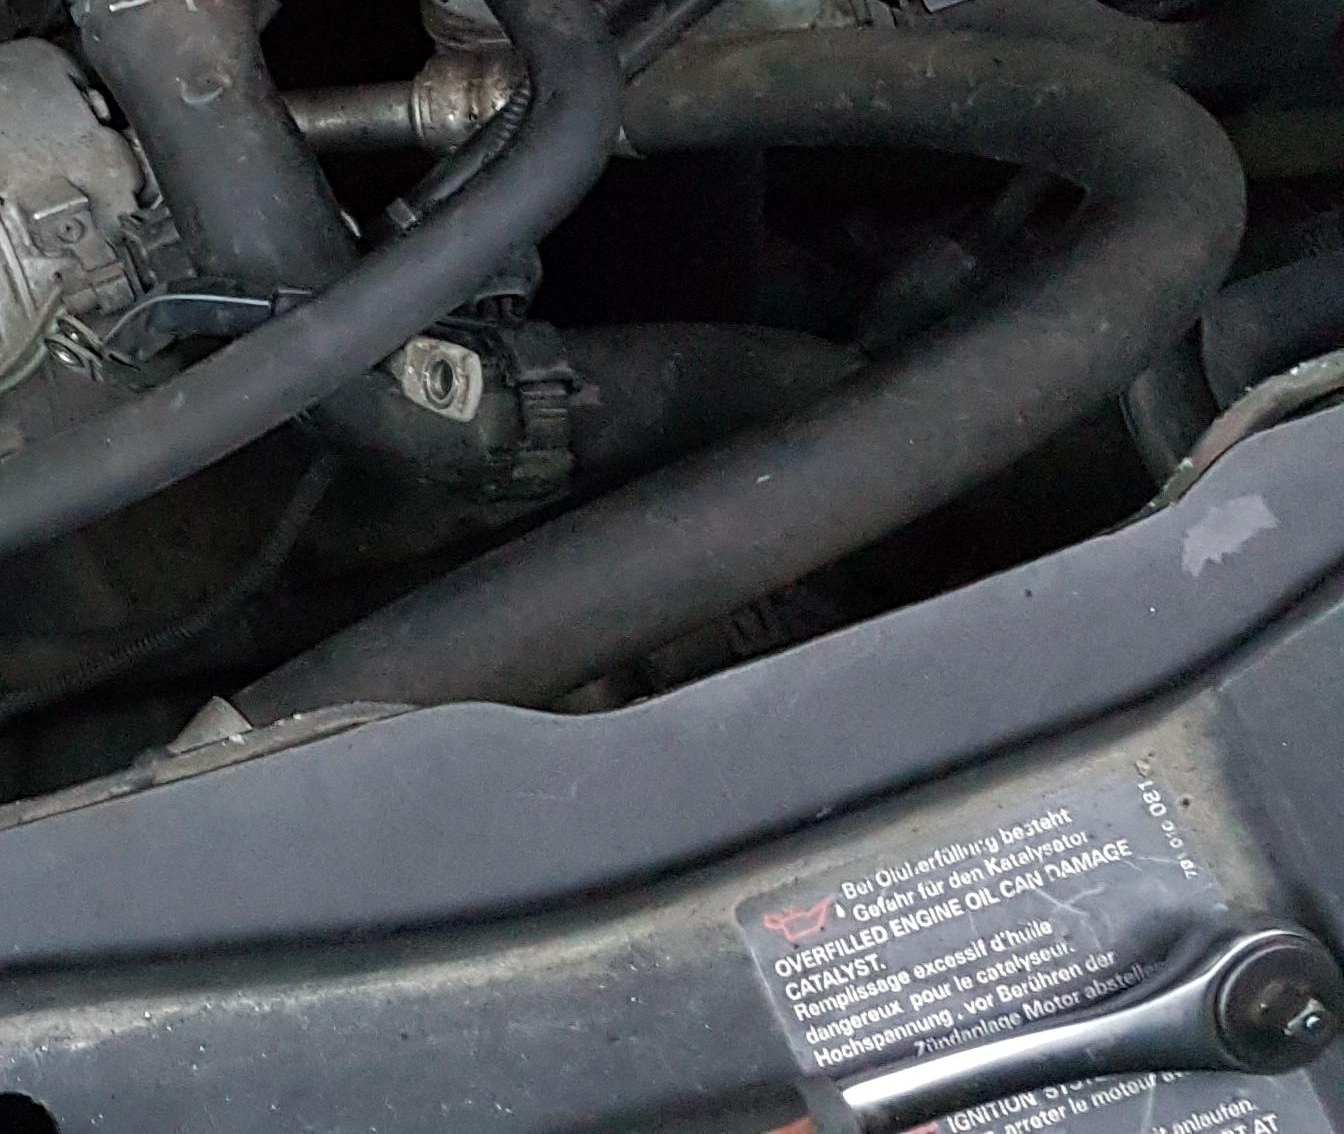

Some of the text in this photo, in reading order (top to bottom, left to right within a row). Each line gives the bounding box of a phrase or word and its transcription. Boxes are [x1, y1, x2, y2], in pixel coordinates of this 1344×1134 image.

[841, 876, 875, 900] Bei
[998, 808, 1073, 844] besteht
[852, 831, 1088, 921] Gefahr für den Katalysator
[774, 839, 1133, 978] OVERFILLED ENGINE OIL CAN DAMAGE
[784, 952, 887, 1001] CATALYST.
[792, 919, 1054, 1021] Remplissage excessif d'huile
[963, 993, 994, 1014] vor
[995, 963, 1084, 1003] Berühren
[1084, 950, 1117, 972] der
[805, 999, 904, 1044] dangereux
[909, 982, 952, 1011] pour
[953, 974, 973, 992] le
[1022, 988, 1081, 1021] Motor
[946, 1090, 1037, 1134] IGNITION
[1068, 1097, 1089, 1114] le
[1092, 1072, 1157, 1107] moteur
